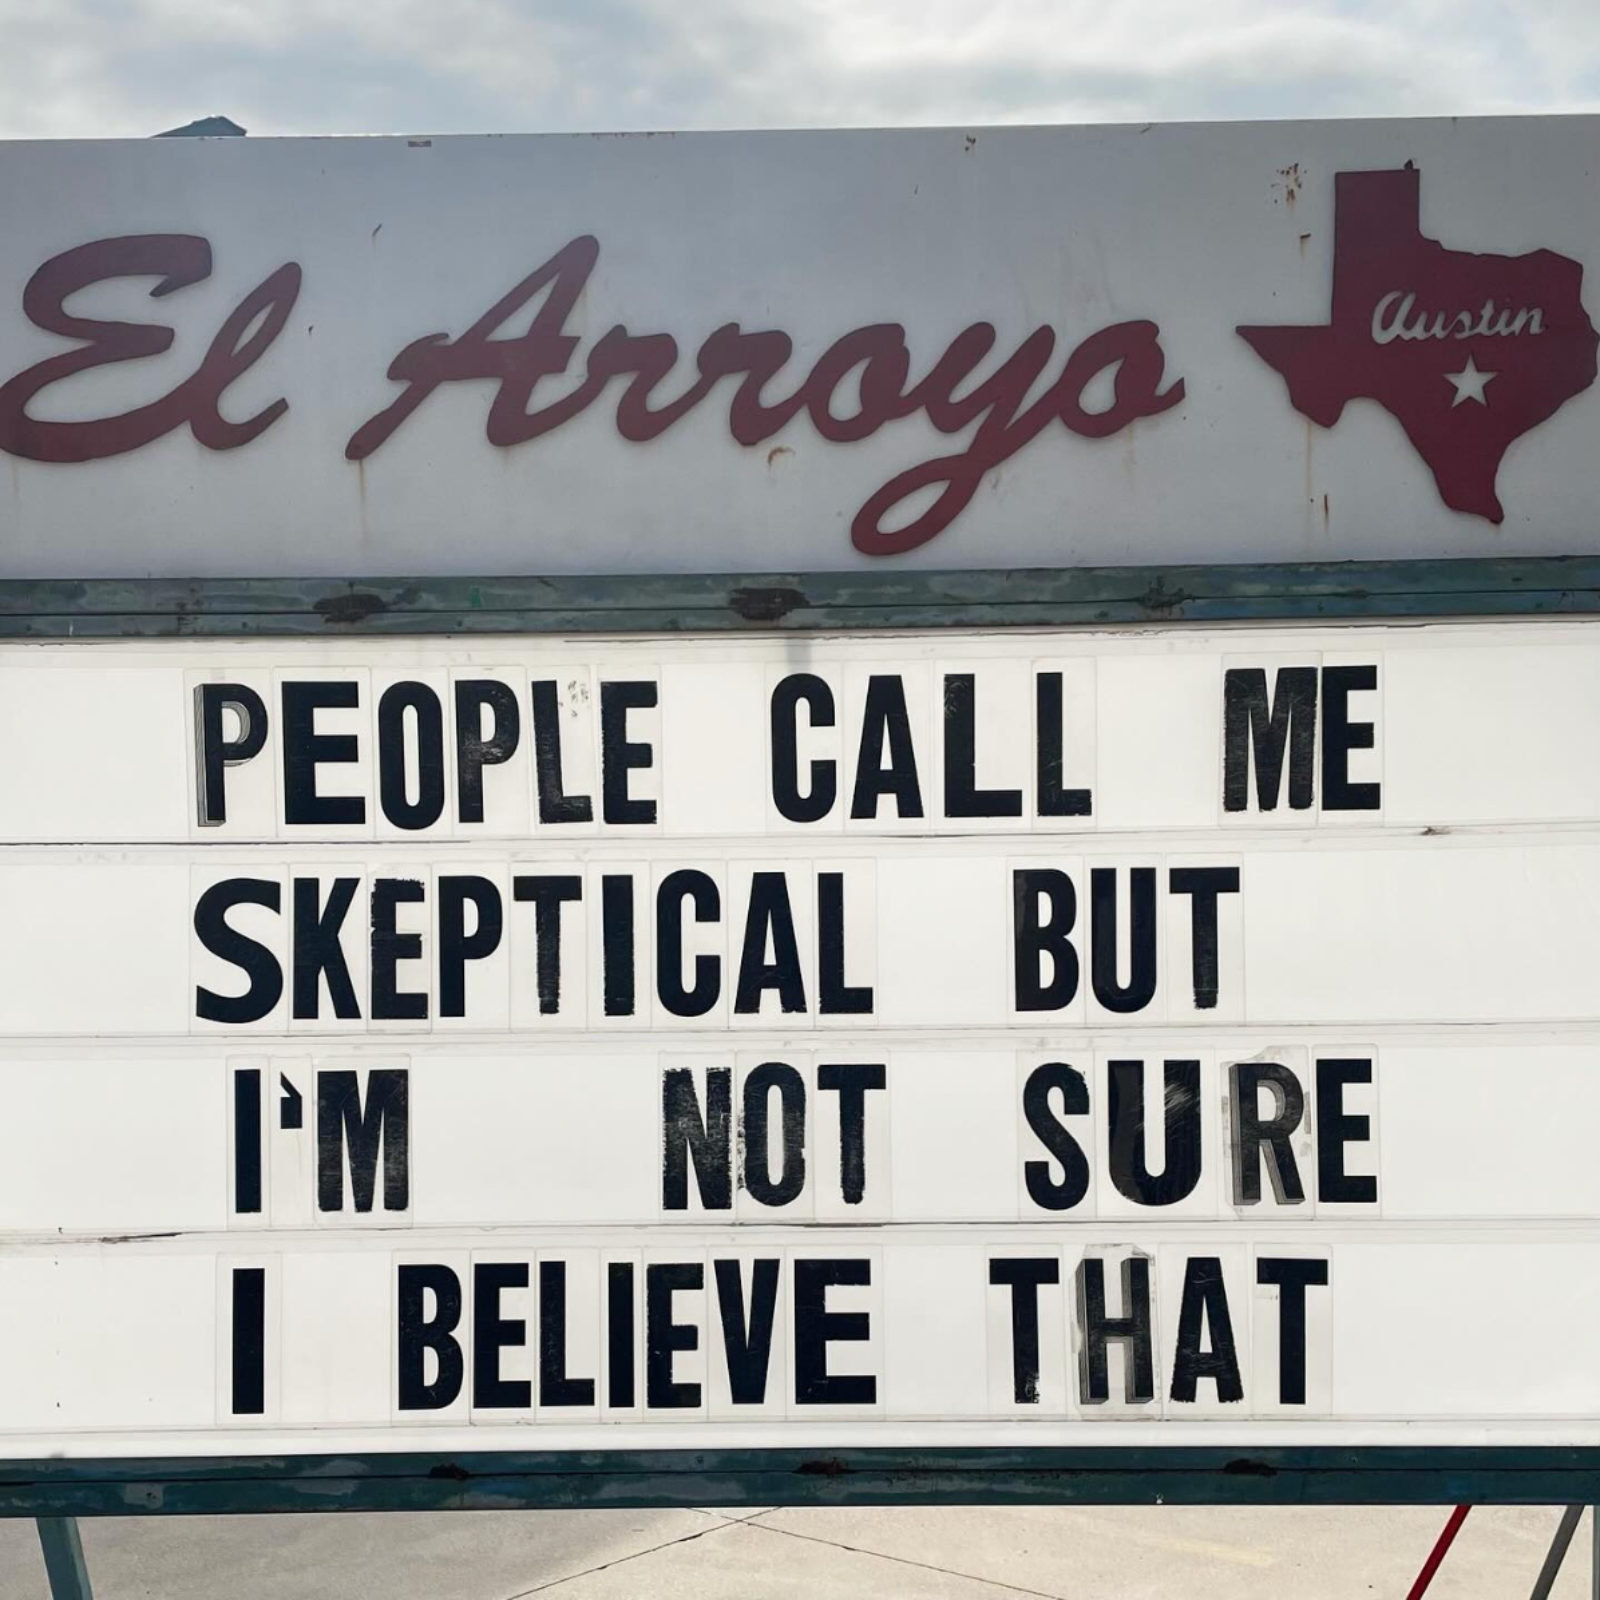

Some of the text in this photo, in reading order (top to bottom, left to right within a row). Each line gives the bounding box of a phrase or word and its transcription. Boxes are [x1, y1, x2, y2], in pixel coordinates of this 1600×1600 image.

[0, 234, 1186, 557] El Arroyo
[1371, 290, 1546, 345] Austin
[194, 665, 1381, 831] PEOPLE CALL ME
[194, 866, 1240, 1024] SKEPTICAL BUT
[662, 1061, 887, 1211] NOT
[1023, 1058, 1378, 1211] SURE
[231, 1256, 1330, 1415] I BELIEVE THAT
